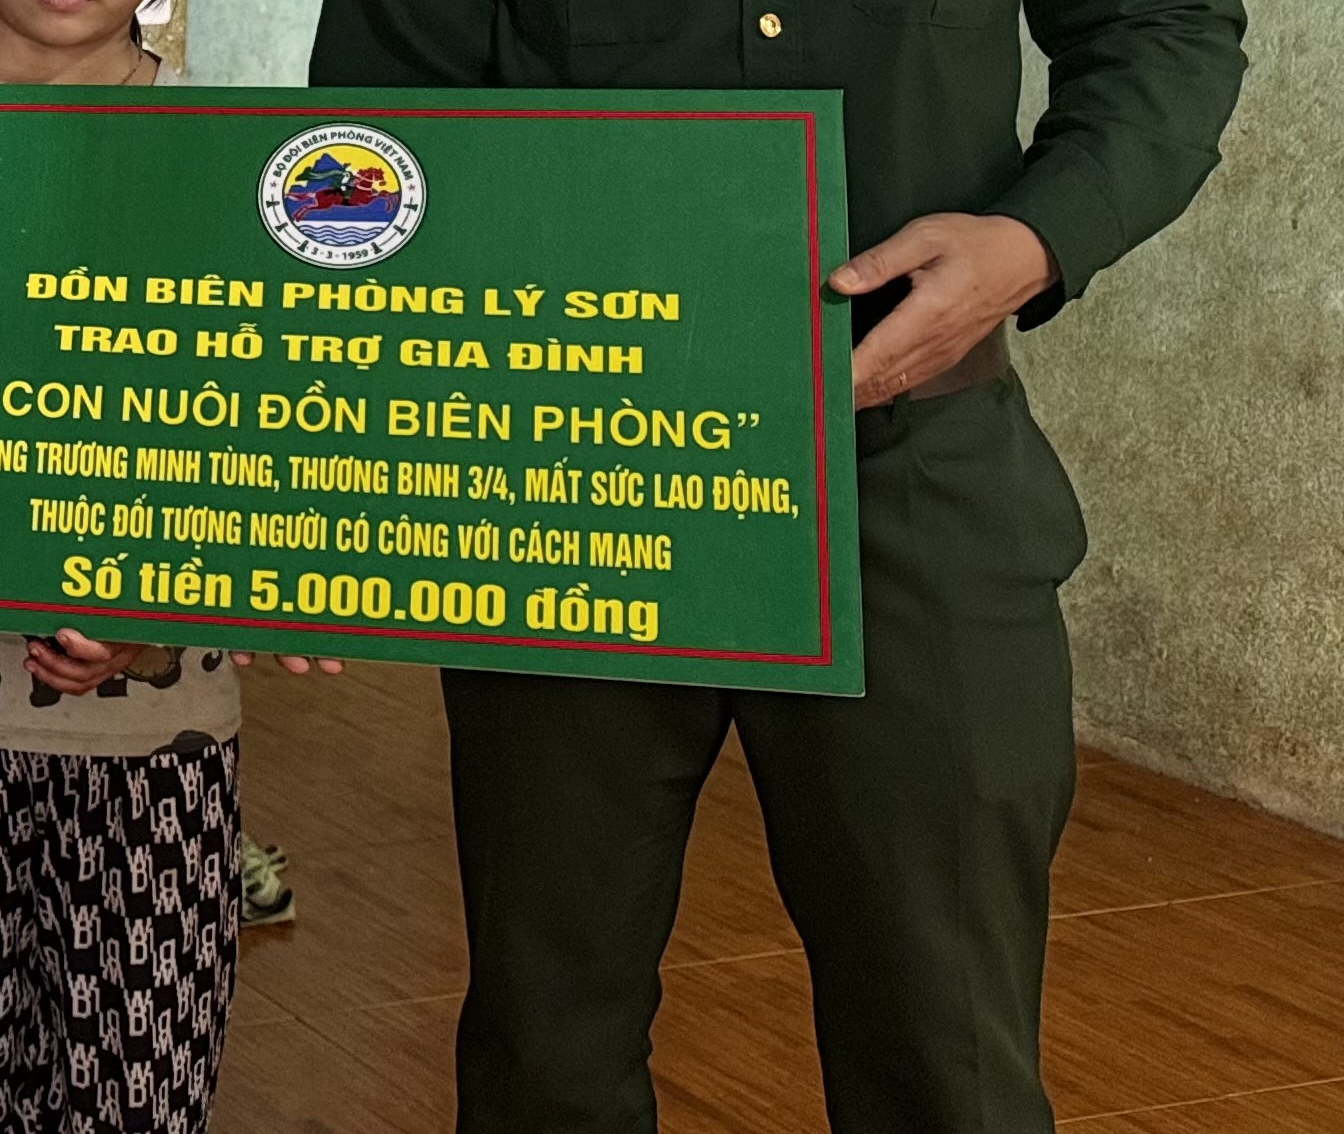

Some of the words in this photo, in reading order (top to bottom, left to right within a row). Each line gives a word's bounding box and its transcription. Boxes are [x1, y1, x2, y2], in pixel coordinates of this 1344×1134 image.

[273, 163, 287, 178] BỘ
[285, 146, 302, 164] ĐỘI
[301, 133, 328, 149] BIÊN
[330, 130, 373, 145] PHÒNG
[375, 139, 398, 158] VIỆT
[395, 157, 414, 181] NAM
[25, 267, 128, 302] ĐỒN
[145, 275, 264, 308] BIÊN
[282, 280, 465, 315] PHÒNG
[483, 284, 544, 317] LÝ
[564, 290, 680, 321] SƠN
[55, 324, 178, 356] TRAO
[195, 322, 263, 360] HỖ
[282, 334, 383, 371] TRỢ
[399, 338, 490, 369] GIA
[507, 339, 643, 374] ĐÌNH
[121, 384, 240, 428] NUÔI
[257, 380, 367, 434] ĐỒN
[388, 392, 511, 441] BIÊN
[533, 399, 761, 452] PHÒNG”
[35, 440, 129, 480] TRƯƠNG
[135, 447, 202, 484] MINH
[208, 445, 281, 493] TÙNG,
[288, 454, 389, 495] THƯƠNG
[397, 462, 460, 499] BINH
[467, 466, 517, 506] 3/4,
[524, 457, 583, 504] MẤT
[590, 464, 645, 508] SỨC
[653, 473, 704, 511] LAO
[711, 470, 800, 520] ĐỘNG,
[30, 495, 106, 542] THUỘC
[112, 494, 154, 540] ĐỐI
[161, 506, 243, 550] TƯỢNG
[249, 507, 328, 551] NGƯỜI
[335, 511, 370, 554] CÓ
[378, 514, 450, 559] CÔNG
[457, 518, 500, 562] VỚI
[508, 521, 580, 566] CÁCH
[589, 531, 672, 576] MẠNG
[61, 553, 129, 600] Số
[138, 556, 233, 608] tiền
[249, 569, 506, 627] 5.000.000
[525, 581, 660, 643] đồng
